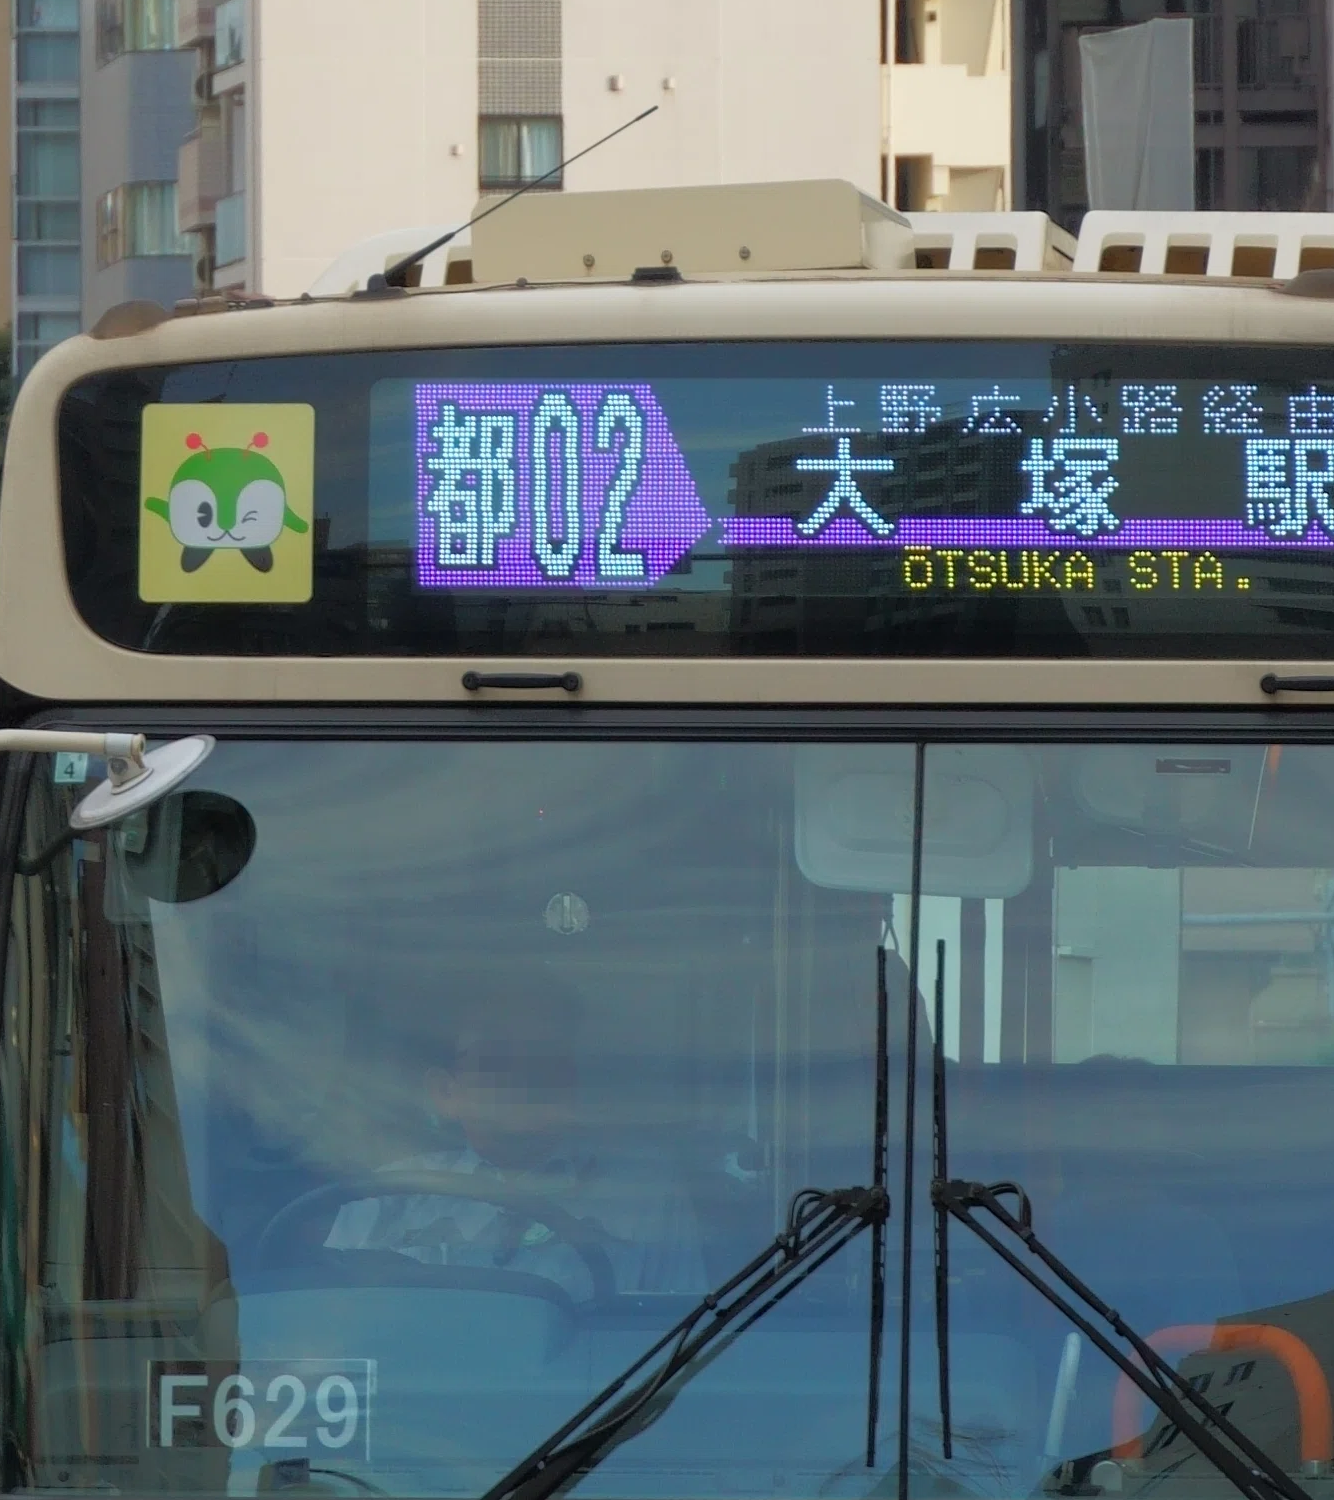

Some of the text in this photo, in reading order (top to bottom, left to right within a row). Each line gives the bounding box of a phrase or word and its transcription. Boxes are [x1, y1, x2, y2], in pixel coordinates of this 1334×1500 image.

[428, 391, 646, 577] 都02
[1128, 551, 1251, 591] STA.
[63, 761, 75, 779] 4
[158, 1372, 362, 1449] F629
